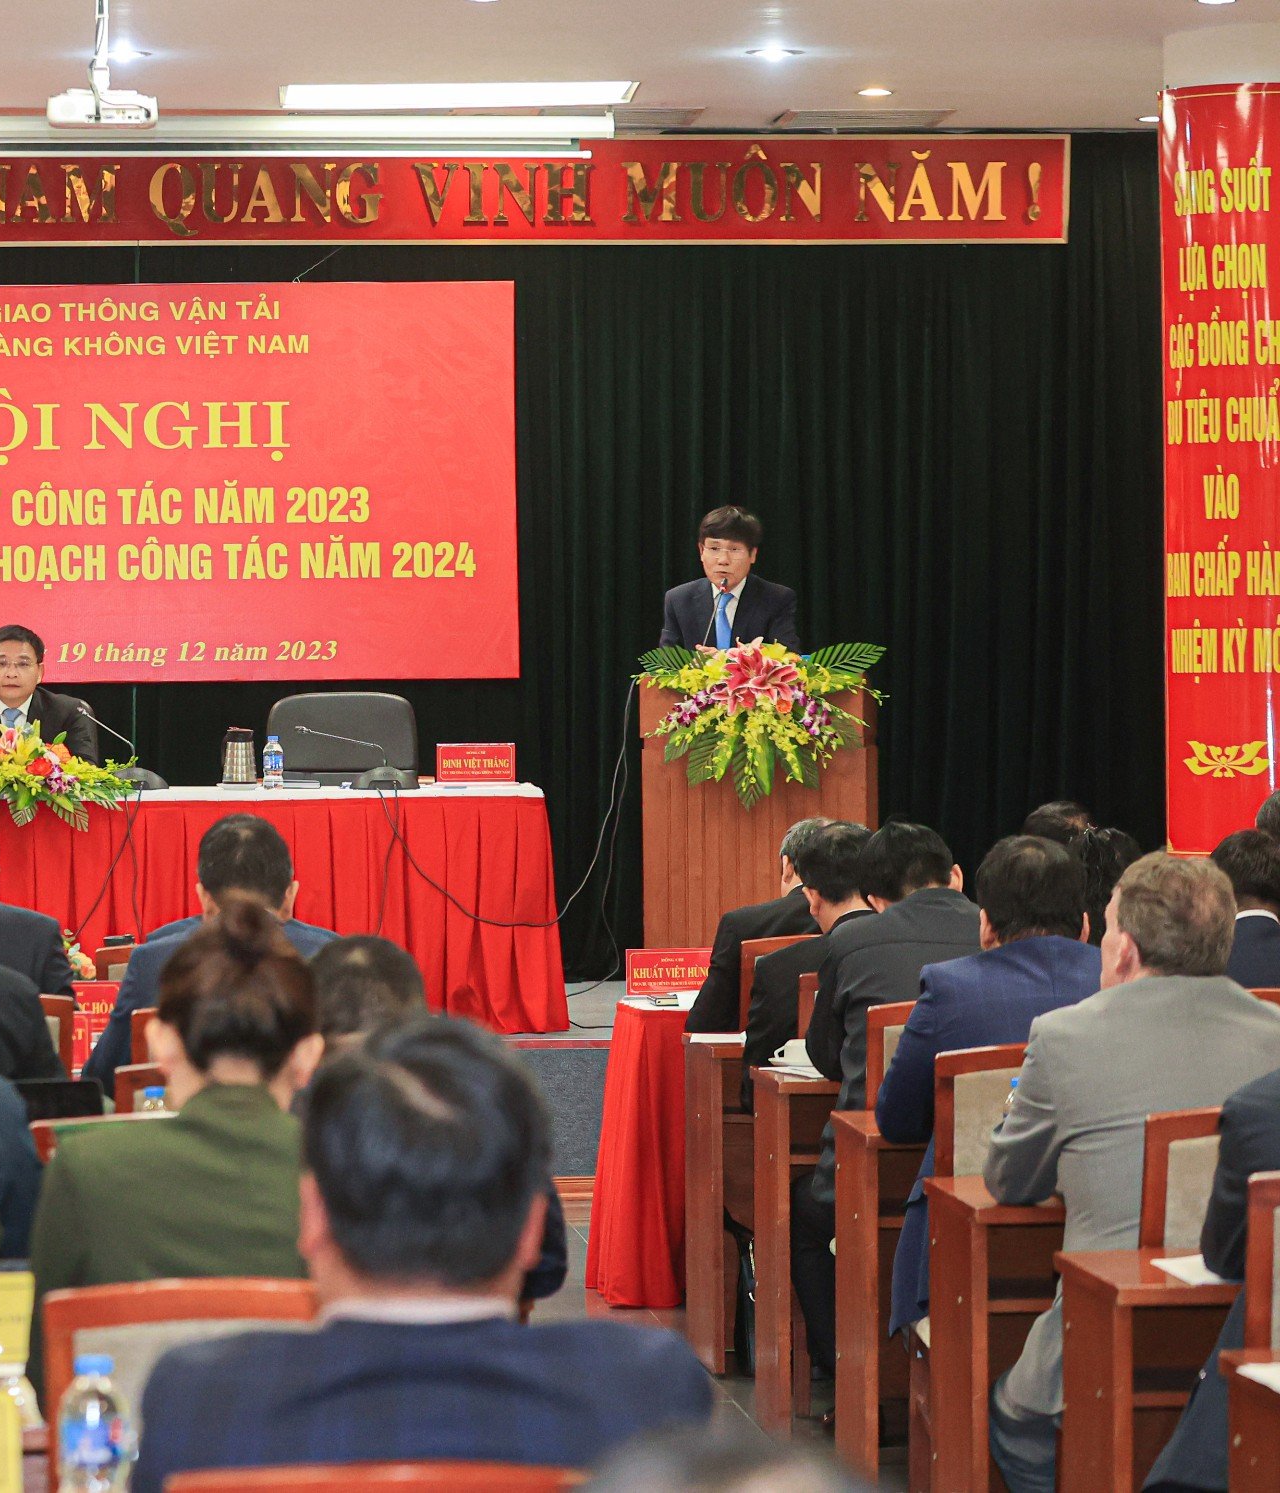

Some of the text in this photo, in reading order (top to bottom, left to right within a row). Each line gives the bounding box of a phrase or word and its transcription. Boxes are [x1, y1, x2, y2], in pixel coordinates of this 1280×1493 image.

[148, 162, 384, 237] QUANG
[414, 162, 593, 225] VINH
[622, 143, 821, 222] MUÔN
[854, 149, 1007, 222] NĂM
[1174, 150, 1272, 217] SÁNG SUỐT
[1179, 242, 1267, 301] LỰA CHỌN
[61, 298, 160, 322] THÔNG
[169, 297, 228, 326] VẬN
[236, 293, 282, 321] TẢI
[1169, 306, 1280, 370] CÁC ĐỒNG CH
[63, 331, 167, 357] KHÔNG
[176, 331, 239, 360] VIỆT
[247, 334, 310, 355] NAM
[84, 400, 290, 462] NGHỊ
[1185, 388, 1221, 444] TIÊU
[1226, 377, 1280, 443] CHUẨ
[12, 481, 108, 526] CÔNG
[117, 479, 183, 525] TÁC
[195, 479, 276, 525] NĂM
[286, 485, 371, 524] 2023
[1202, 464, 1241, 520] VÀO
[117, 536, 213, 581] CÔNG
[224, 535, 289, 580] TÁC
[301, 534, 381, 580] NĂM
[392, 541, 477, 579] 2024
[1167, 534, 1280, 598] BAN CHẤP HÀ
[57, 642, 87, 663] 19
[93, 642, 167, 667] tháng
[178, 642, 207, 662] 12
[214, 642, 270, 662] năm
[278, 640, 338, 661] 2023
[1171, 618, 1218, 684] NHIỆM
[1222, 617, 1248, 673] KỲ
[463, 756, 482, 770] VIỆT
[633, 963, 664, 979] KHUẤT
[665, 964, 687, 981] VIỆT
